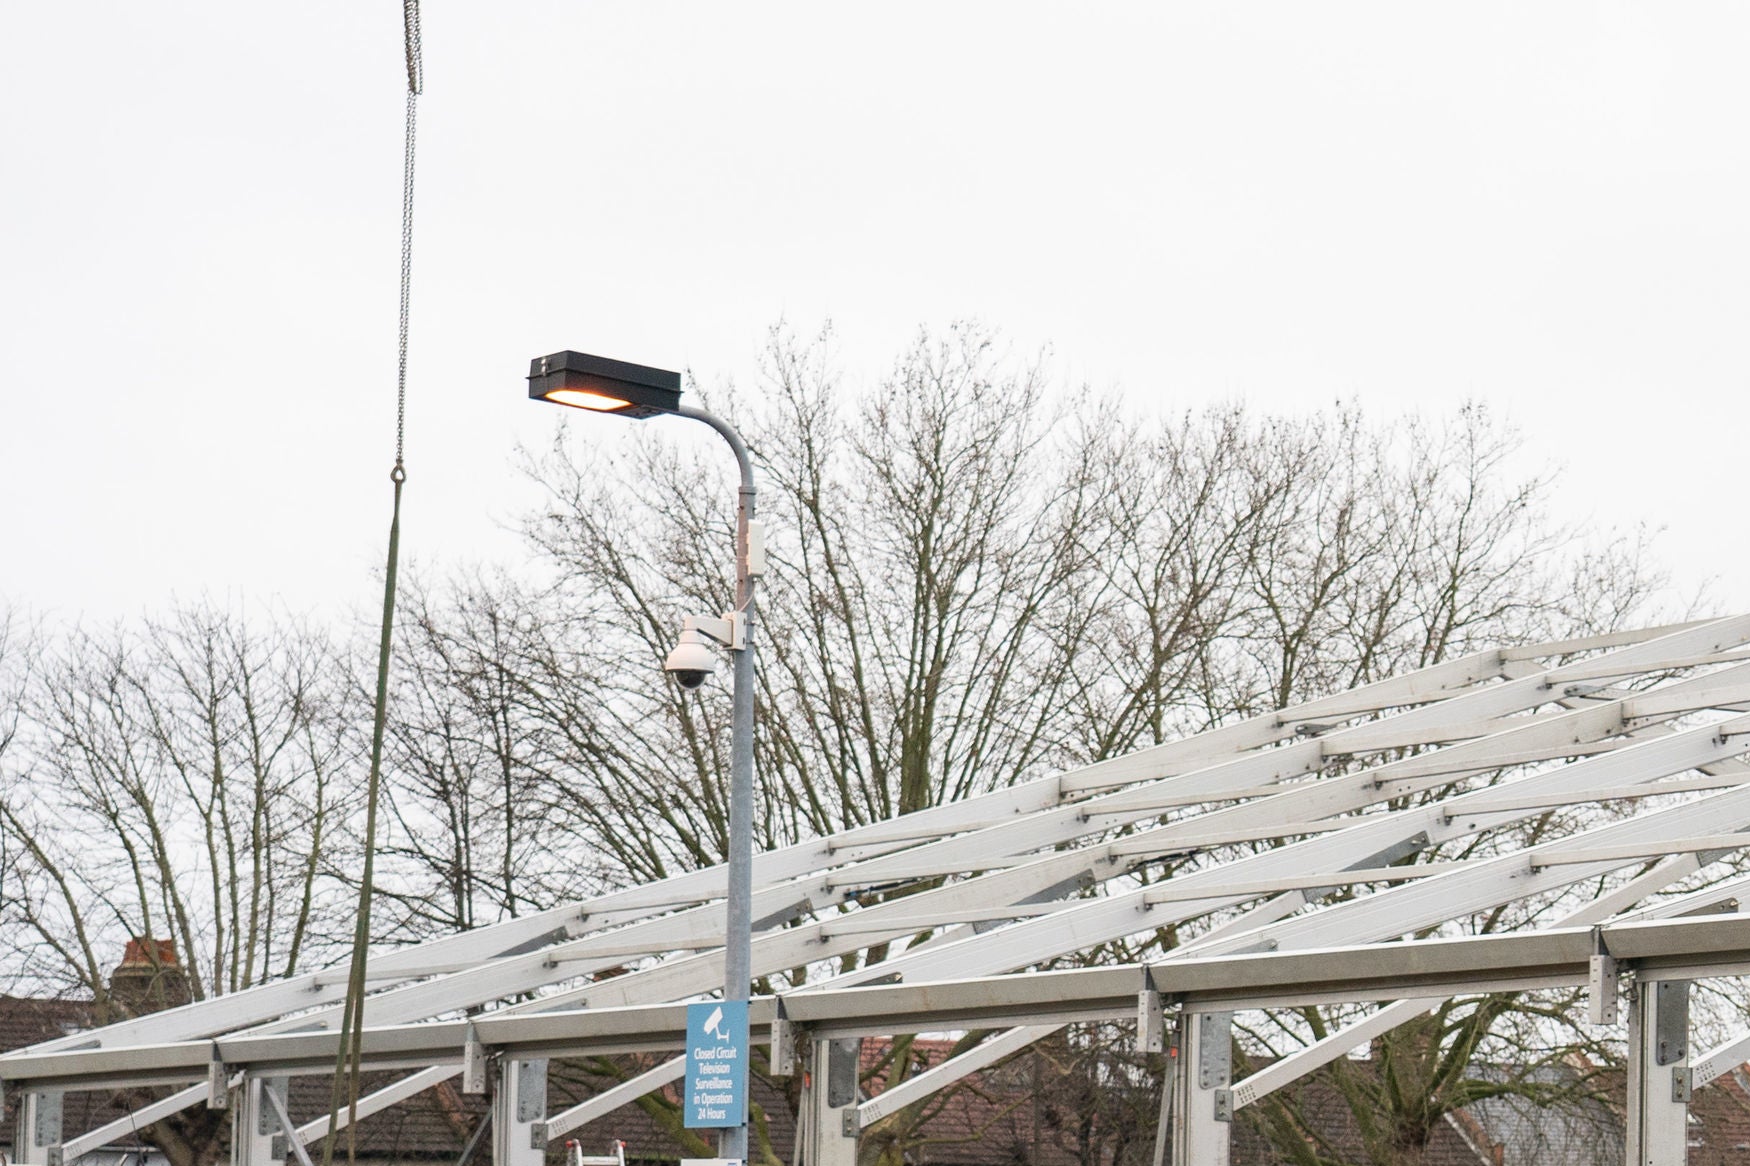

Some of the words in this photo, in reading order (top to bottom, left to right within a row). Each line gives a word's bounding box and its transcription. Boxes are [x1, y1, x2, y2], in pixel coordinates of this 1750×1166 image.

[694, 1047, 715, 1059] Closed
[716, 1046, 737, 1059] Circuit
[699, 1061, 730, 1074] Television
[695, 1077, 733, 1090] Surveillance
[693, 1093, 700, 1104] in
[701, 1092, 733, 1107] Operation
[697, 1108, 706, 1120] 24
[707, 1107, 726, 1120] Hours
